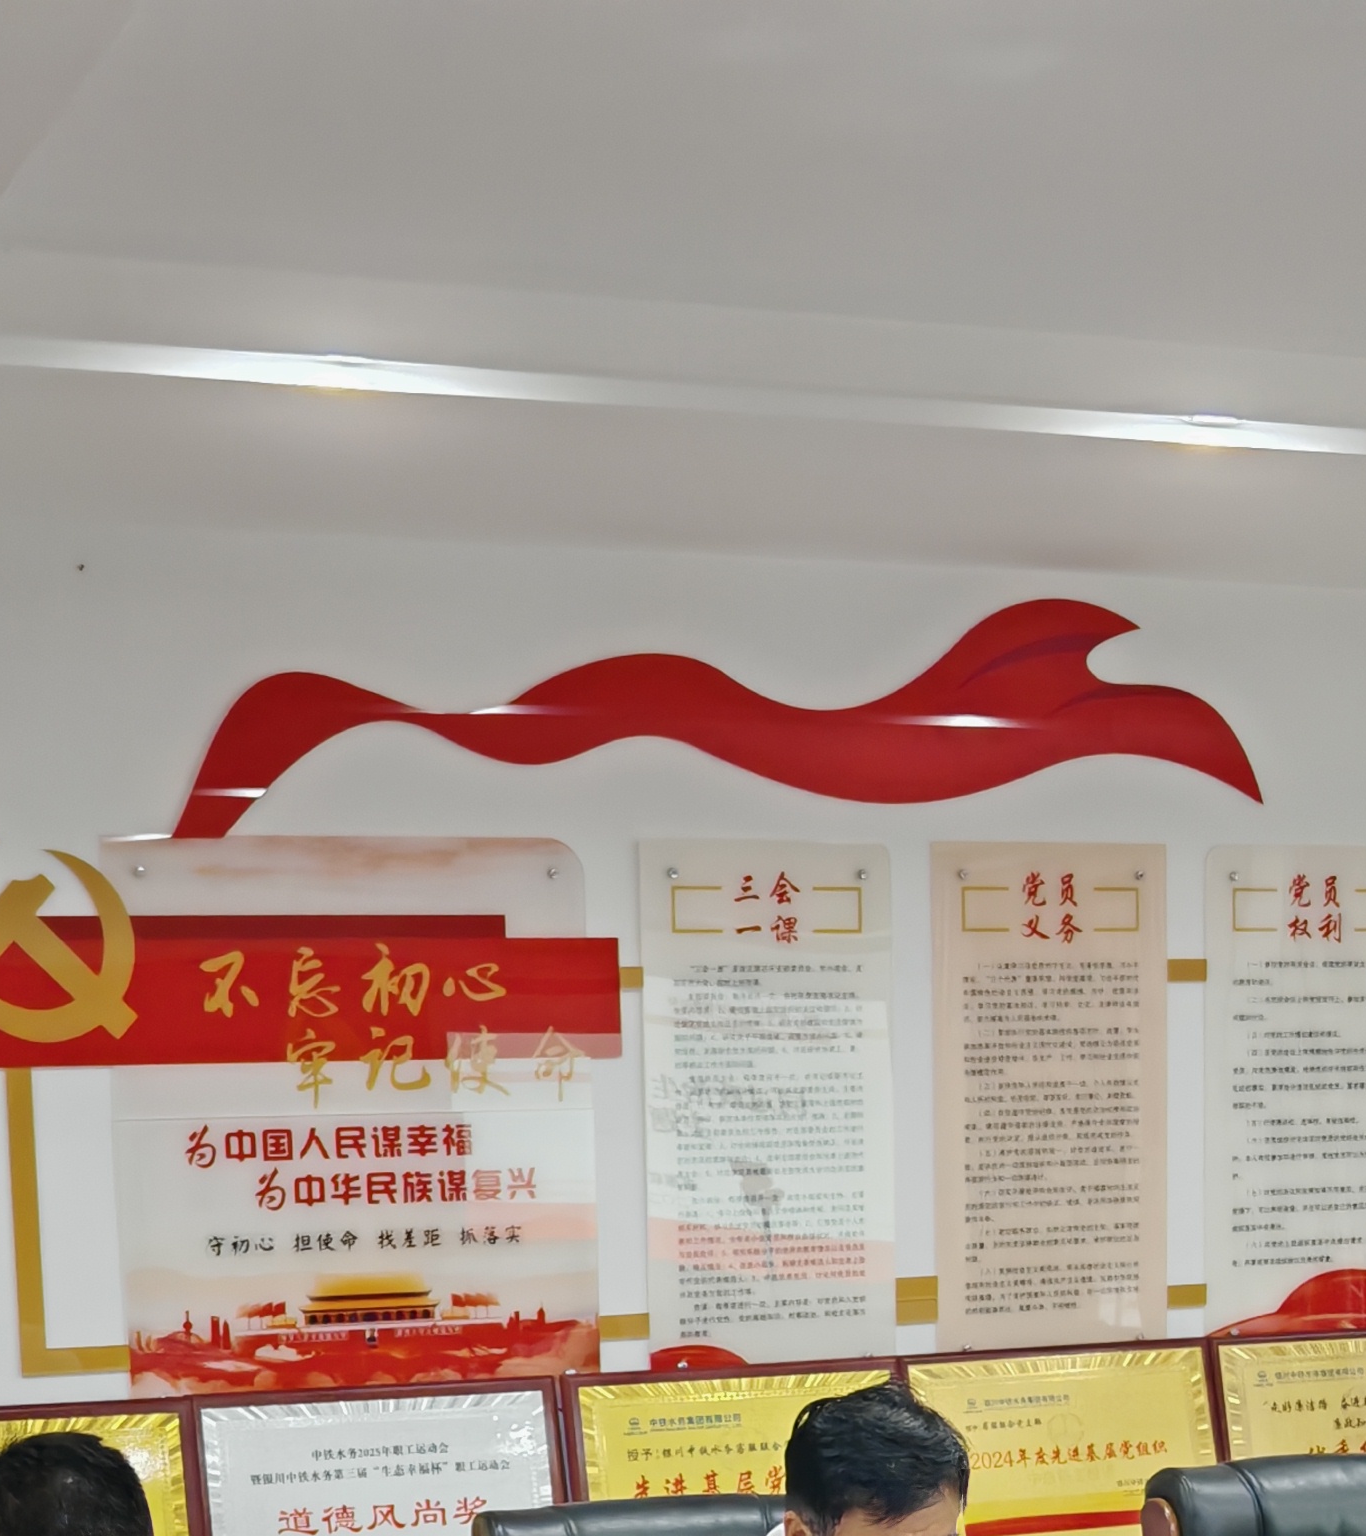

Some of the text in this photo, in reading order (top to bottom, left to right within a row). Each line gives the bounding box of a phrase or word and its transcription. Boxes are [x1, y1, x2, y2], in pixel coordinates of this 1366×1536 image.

[734, 871, 801, 905] 三会
[1021, 871, 1079, 908] 党员
[1288, 873, 1341, 908] 党员
[734, 914, 800, 945] 一课
[1020, 912, 1083, 945] 义务
[1287, 912, 1343, 944] 权利
[196, 942, 509, 1020] 不忘初心
[285, 1026, 584, 1110] 牢记使命
[184, 1122, 475, 1170] 为中国人民谋幸福
[253, 1165, 537, 1212] 为中华民族谋复兴
[206, 1222, 524, 1258] 守初心 担使命 找差距 抓落实
[311, 1442, 449, 1462] 中铁水务2025年职工运动会
[970, 1440, 1168, 1470] 2024年度先进基层党组织
[277, 1495, 489, 1536] 道德风尚奖
